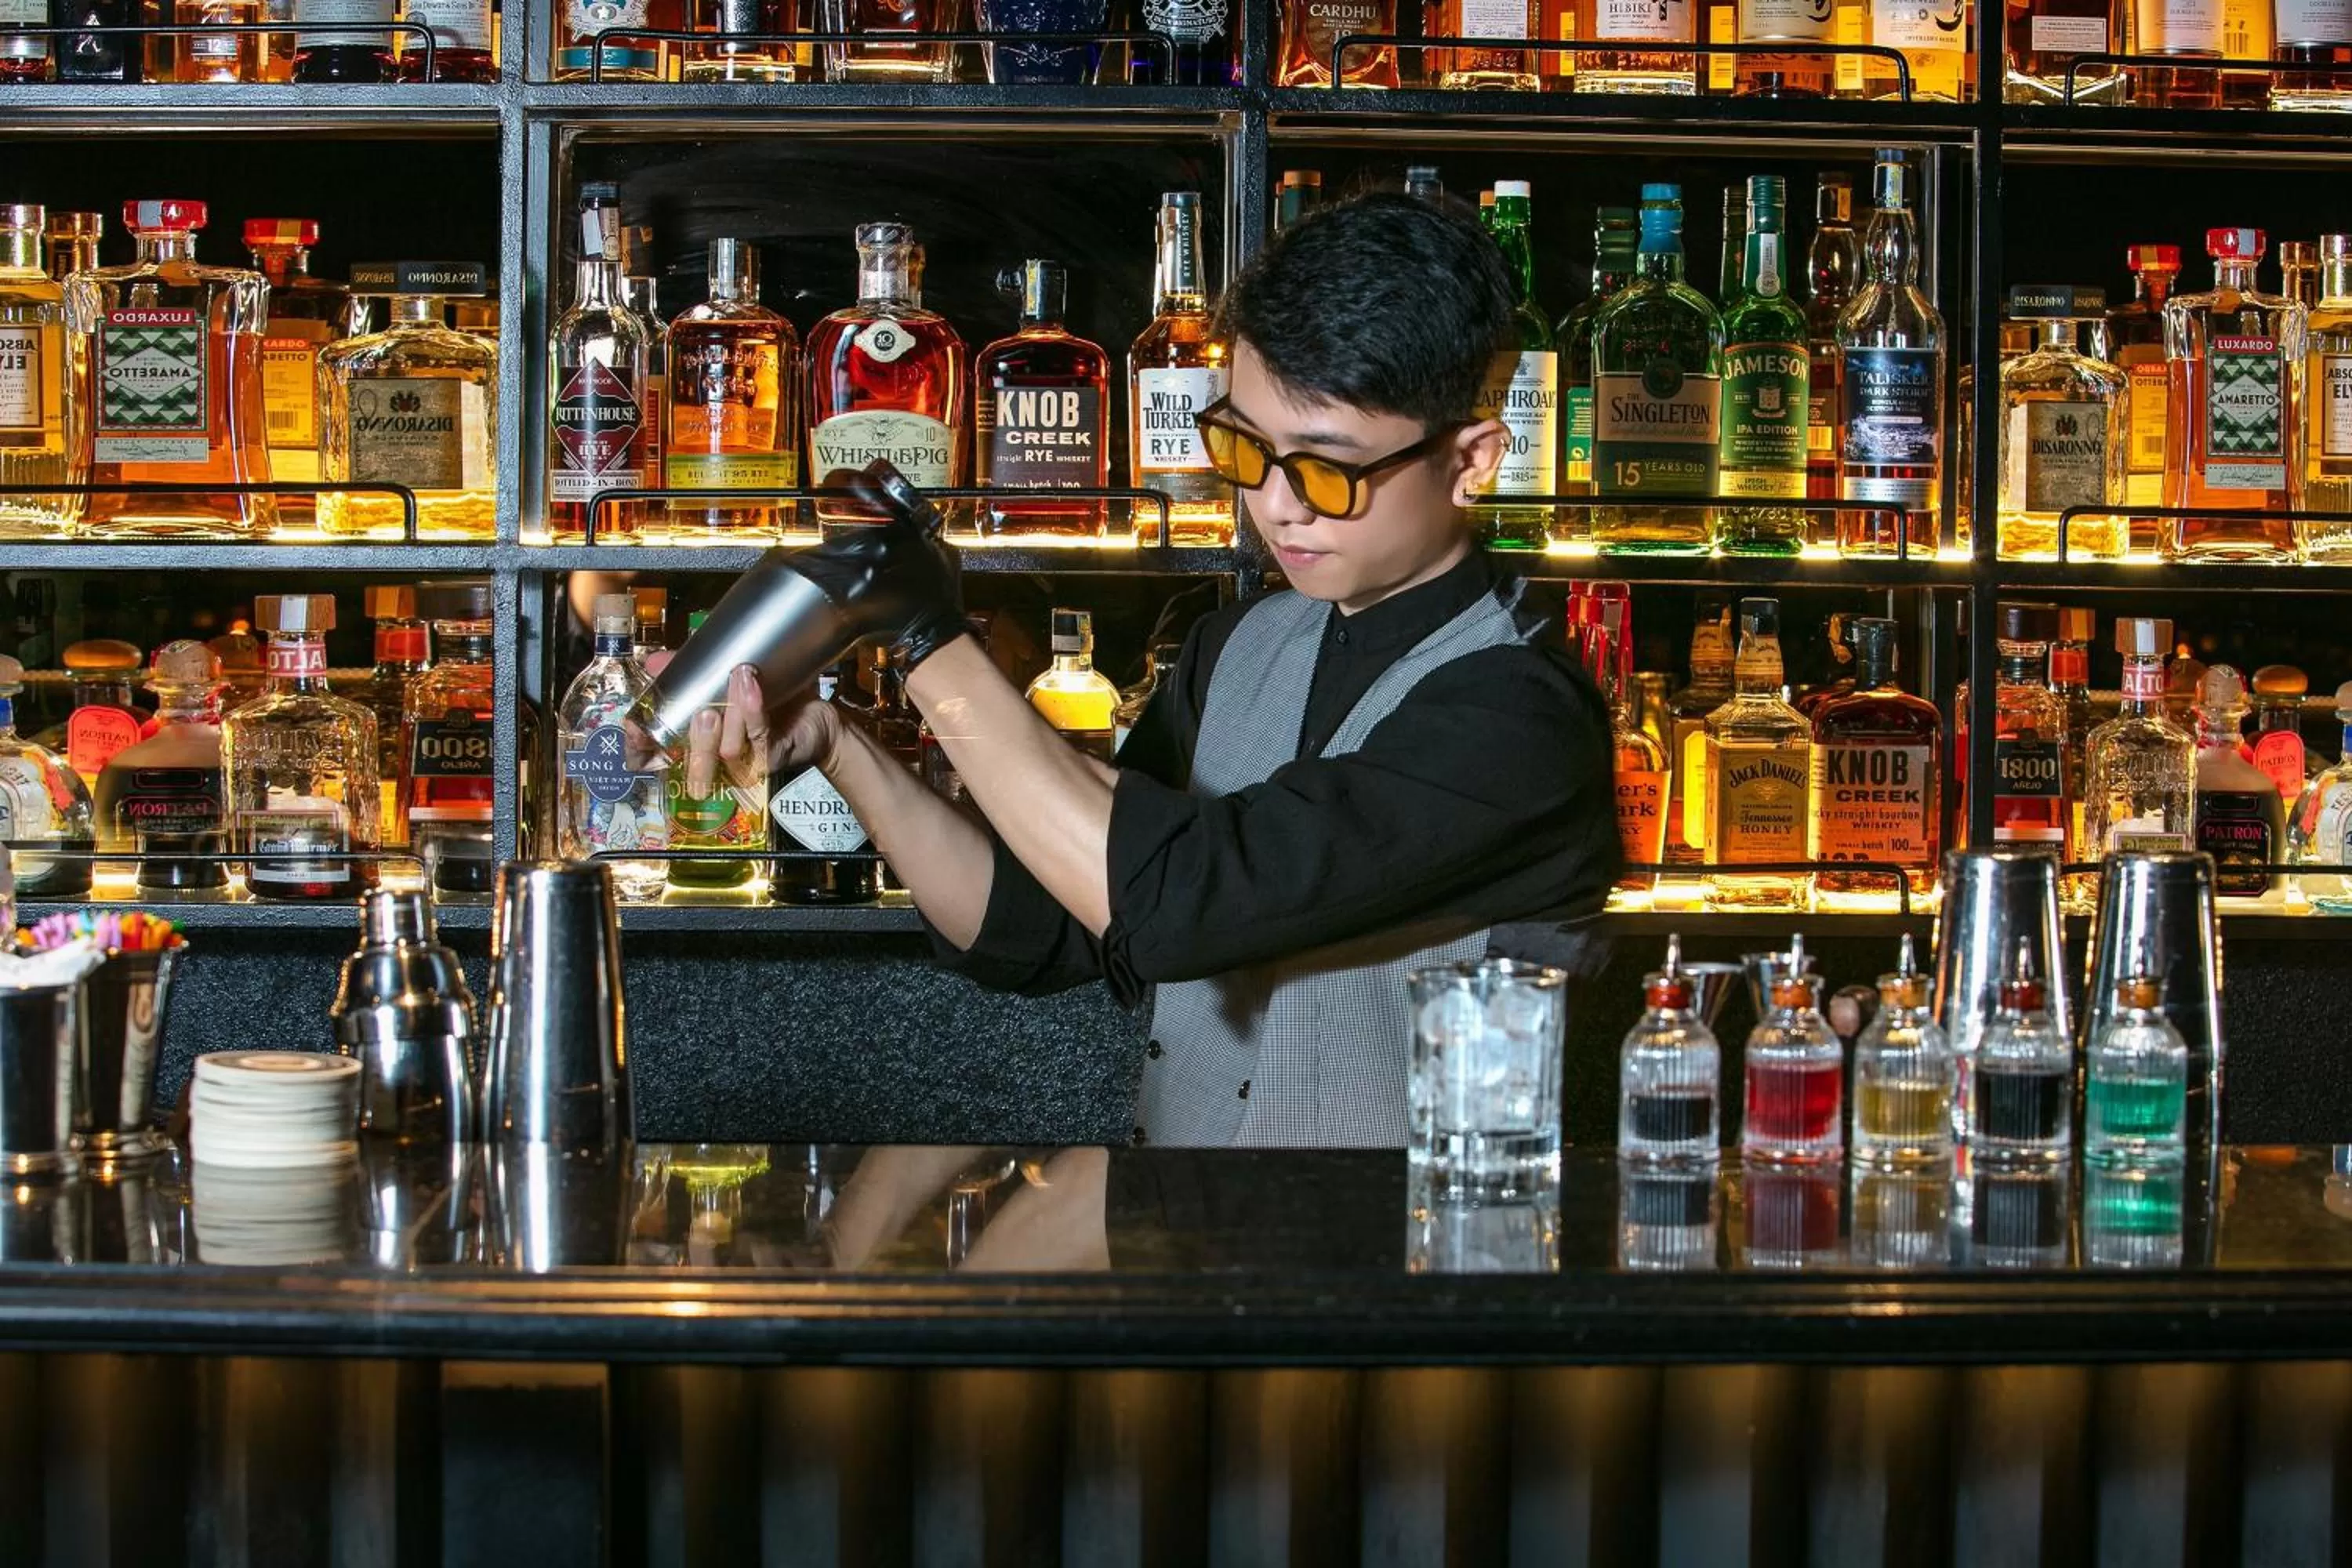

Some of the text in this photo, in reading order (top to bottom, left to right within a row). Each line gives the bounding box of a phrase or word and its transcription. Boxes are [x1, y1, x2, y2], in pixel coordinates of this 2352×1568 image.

[1310, 4, 1377, 19] CARDHU
[1609, 3, 1651, 13] HIBIKI
[2217, 339, 2274, 350] LUXARDO
[1724, 354, 1807, 383] JAMESON
[1858, 372, 1929, 385] TALISKER
[1860, 387, 1889, 397] DARK
[2217, 394, 2276, 405] AMARETTO
[997, 390, 1080, 427] KNOB
[1151, 392, 1192, 412] WILD
[1611, 396, 1711, 424] SINGLETON
[555, 406, 637, 422] RITTENHOUSE
[1143, 407, 1203, 431] TURKEY
[1736, 424, 1798, 435] IPA EDITION
[1005, 430, 1091, 446] CREEK
[1512, 435, 1529, 456] 10
[578, 445, 612, 456] RYE
[1151, 438, 1192, 456] RYE
[2031, 439, 2102, 456] DISARONNO
[1025, 449, 1054, 462] RYE
[1614, 461, 1641, 486] 15
[1645, 462, 1682, 472] YEARS
[2124, 672, 2164, 693] ALTO
[1828, 750, 1908, 786] KNOB
[1999, 757, 2056, 779] 1800
[1730, 764, 1759, 789] JACK
[1835, 789, 1920, 804] CREEK
[818, 822, 851, 833] GIN
[1740, 824, 1791, 835] HONEY
[1890, 838, 1909, 851] 100
